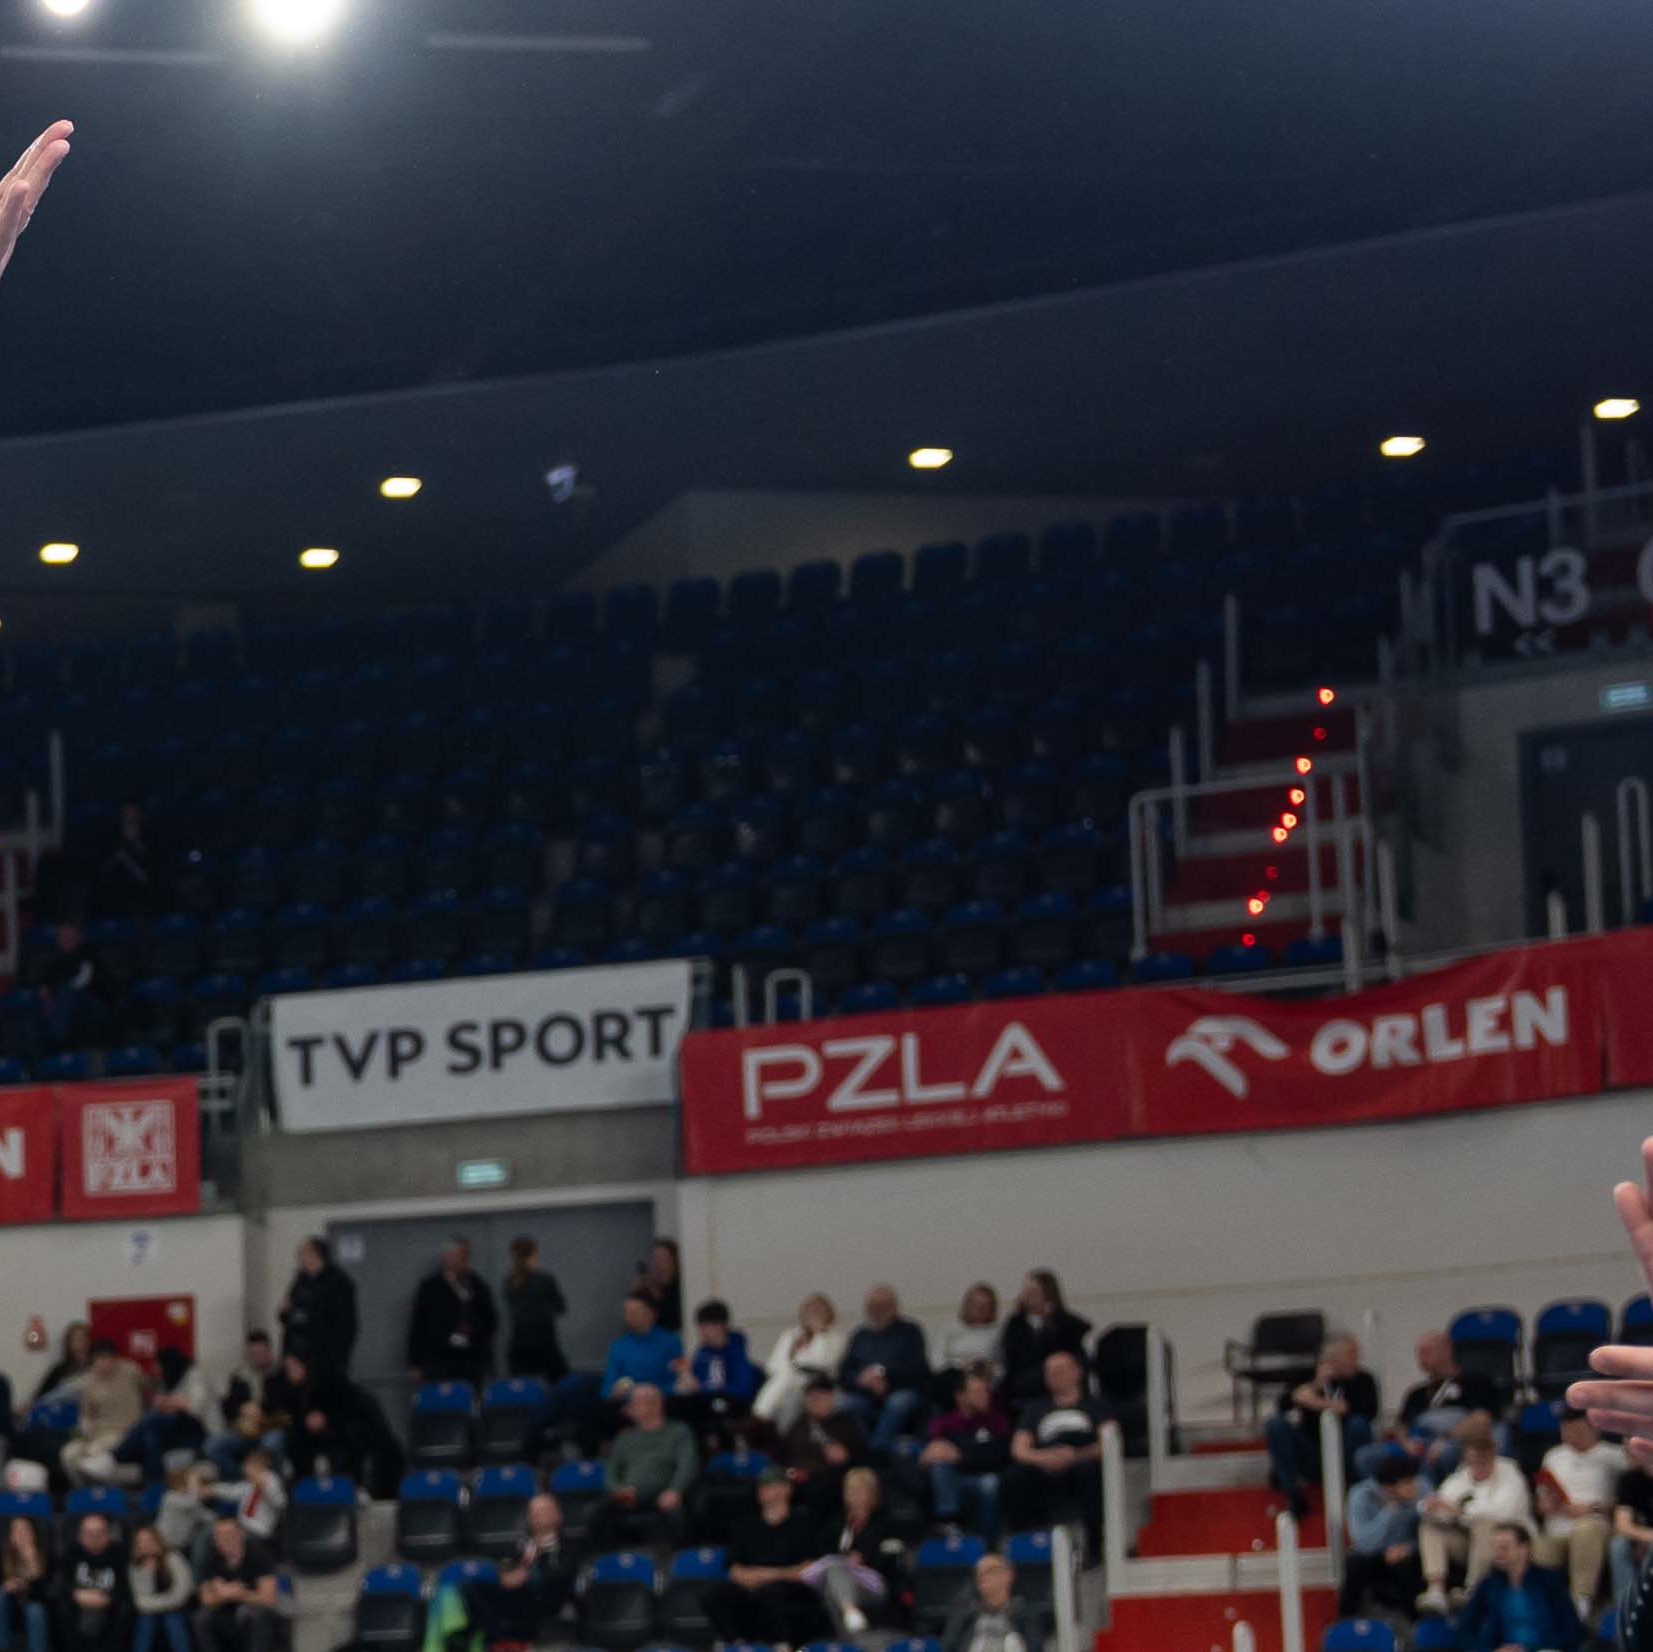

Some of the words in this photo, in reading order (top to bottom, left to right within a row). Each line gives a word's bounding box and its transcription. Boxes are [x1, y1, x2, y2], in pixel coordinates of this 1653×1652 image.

[1473, 546, 1590, 637] N3
[289, 1028, 425, 1088] TVP
[446, 1006, 676, 1077] SPORT
[742, 1021, 1066, 1120] PZLA
[1310, 986, 1567, 1077] ORLEN
